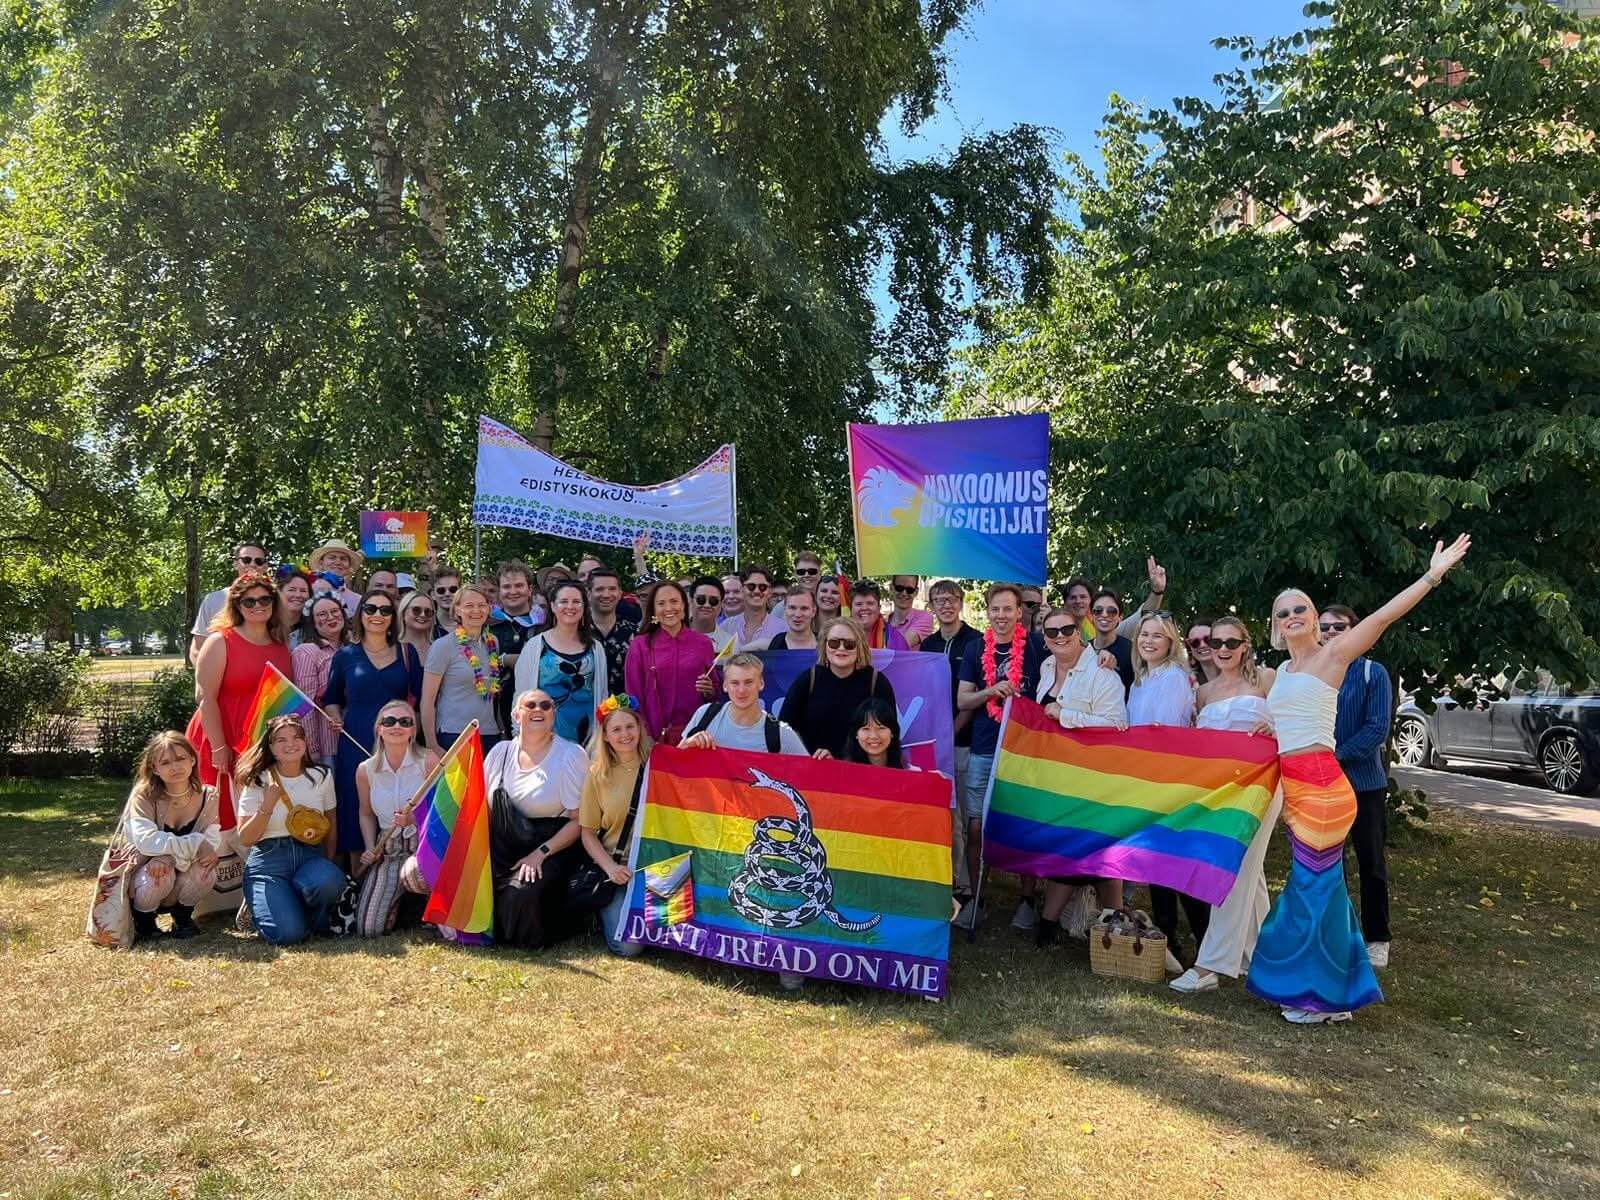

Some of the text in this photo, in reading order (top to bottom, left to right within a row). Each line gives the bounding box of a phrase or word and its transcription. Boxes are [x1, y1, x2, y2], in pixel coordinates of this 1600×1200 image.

[716, 933, 817, 974] TREAD
[828, 952, 883, 983] ON
[889, 960, 940, 992] ME
